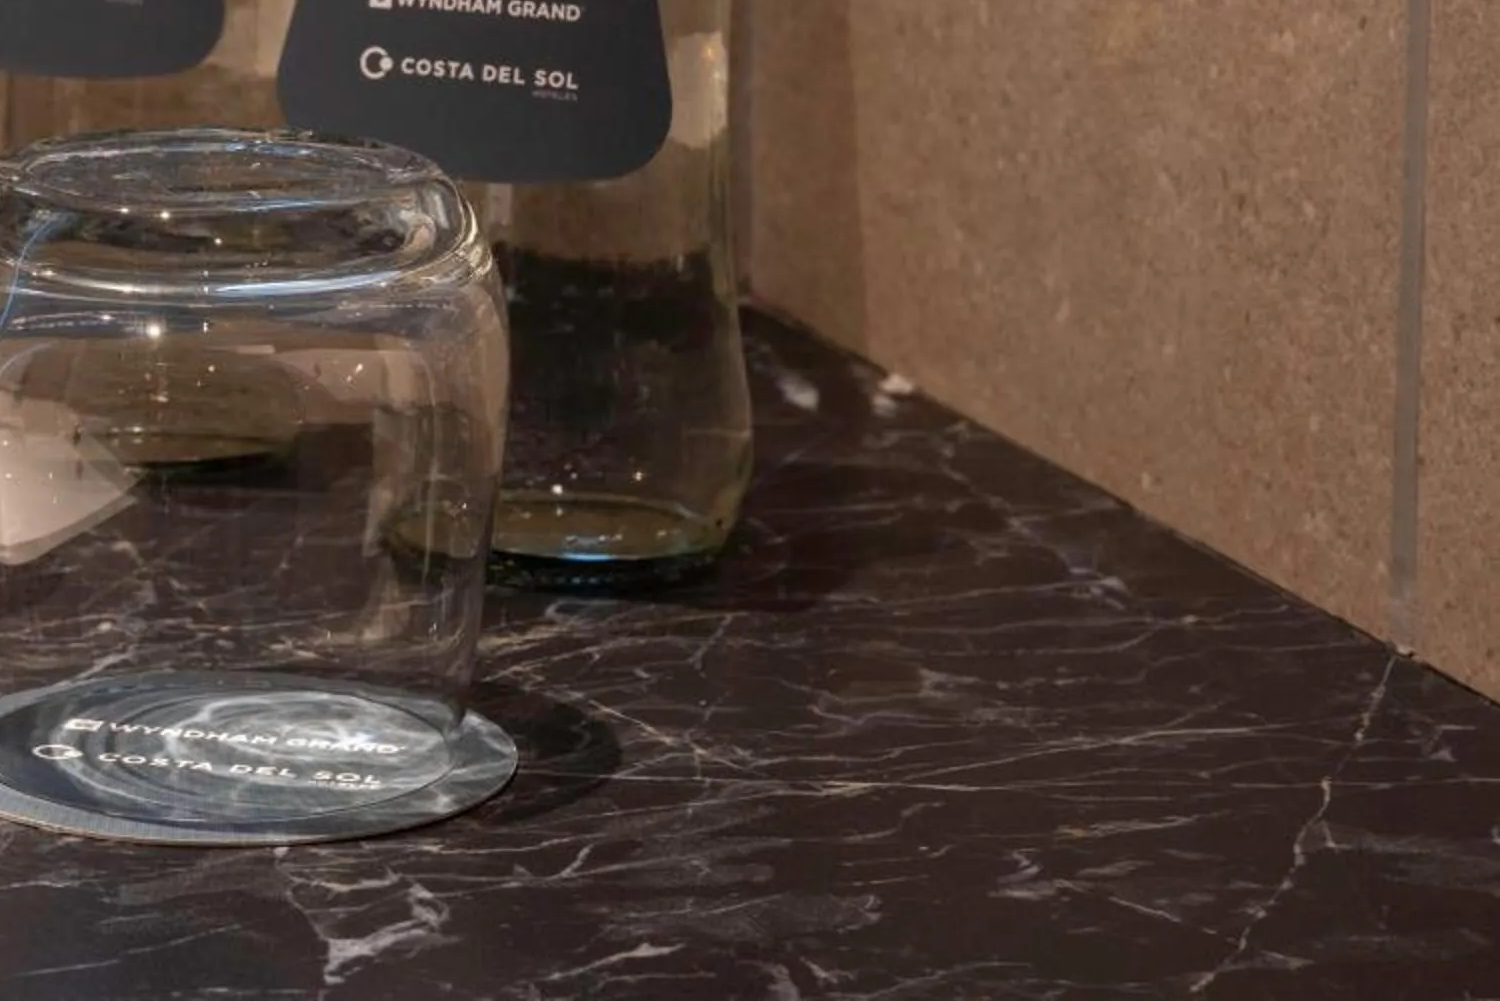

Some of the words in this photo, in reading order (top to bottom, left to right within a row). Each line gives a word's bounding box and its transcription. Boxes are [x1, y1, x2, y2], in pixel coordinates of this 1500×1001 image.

[508, 0, 582, 22] GRAND
[401, 56, 474, 79] COSTA
[482, 64, 526, 85] DEL
[533, 69, 579, 90] SOL
[109, 722, 278, 745] WYNDHAM
[287, 737, 399, 755] GRAND
[98, 752, 213, 772] COSTA
[230, 762, 298, 778] DEL
[313, 770, 382, 784] SOL
